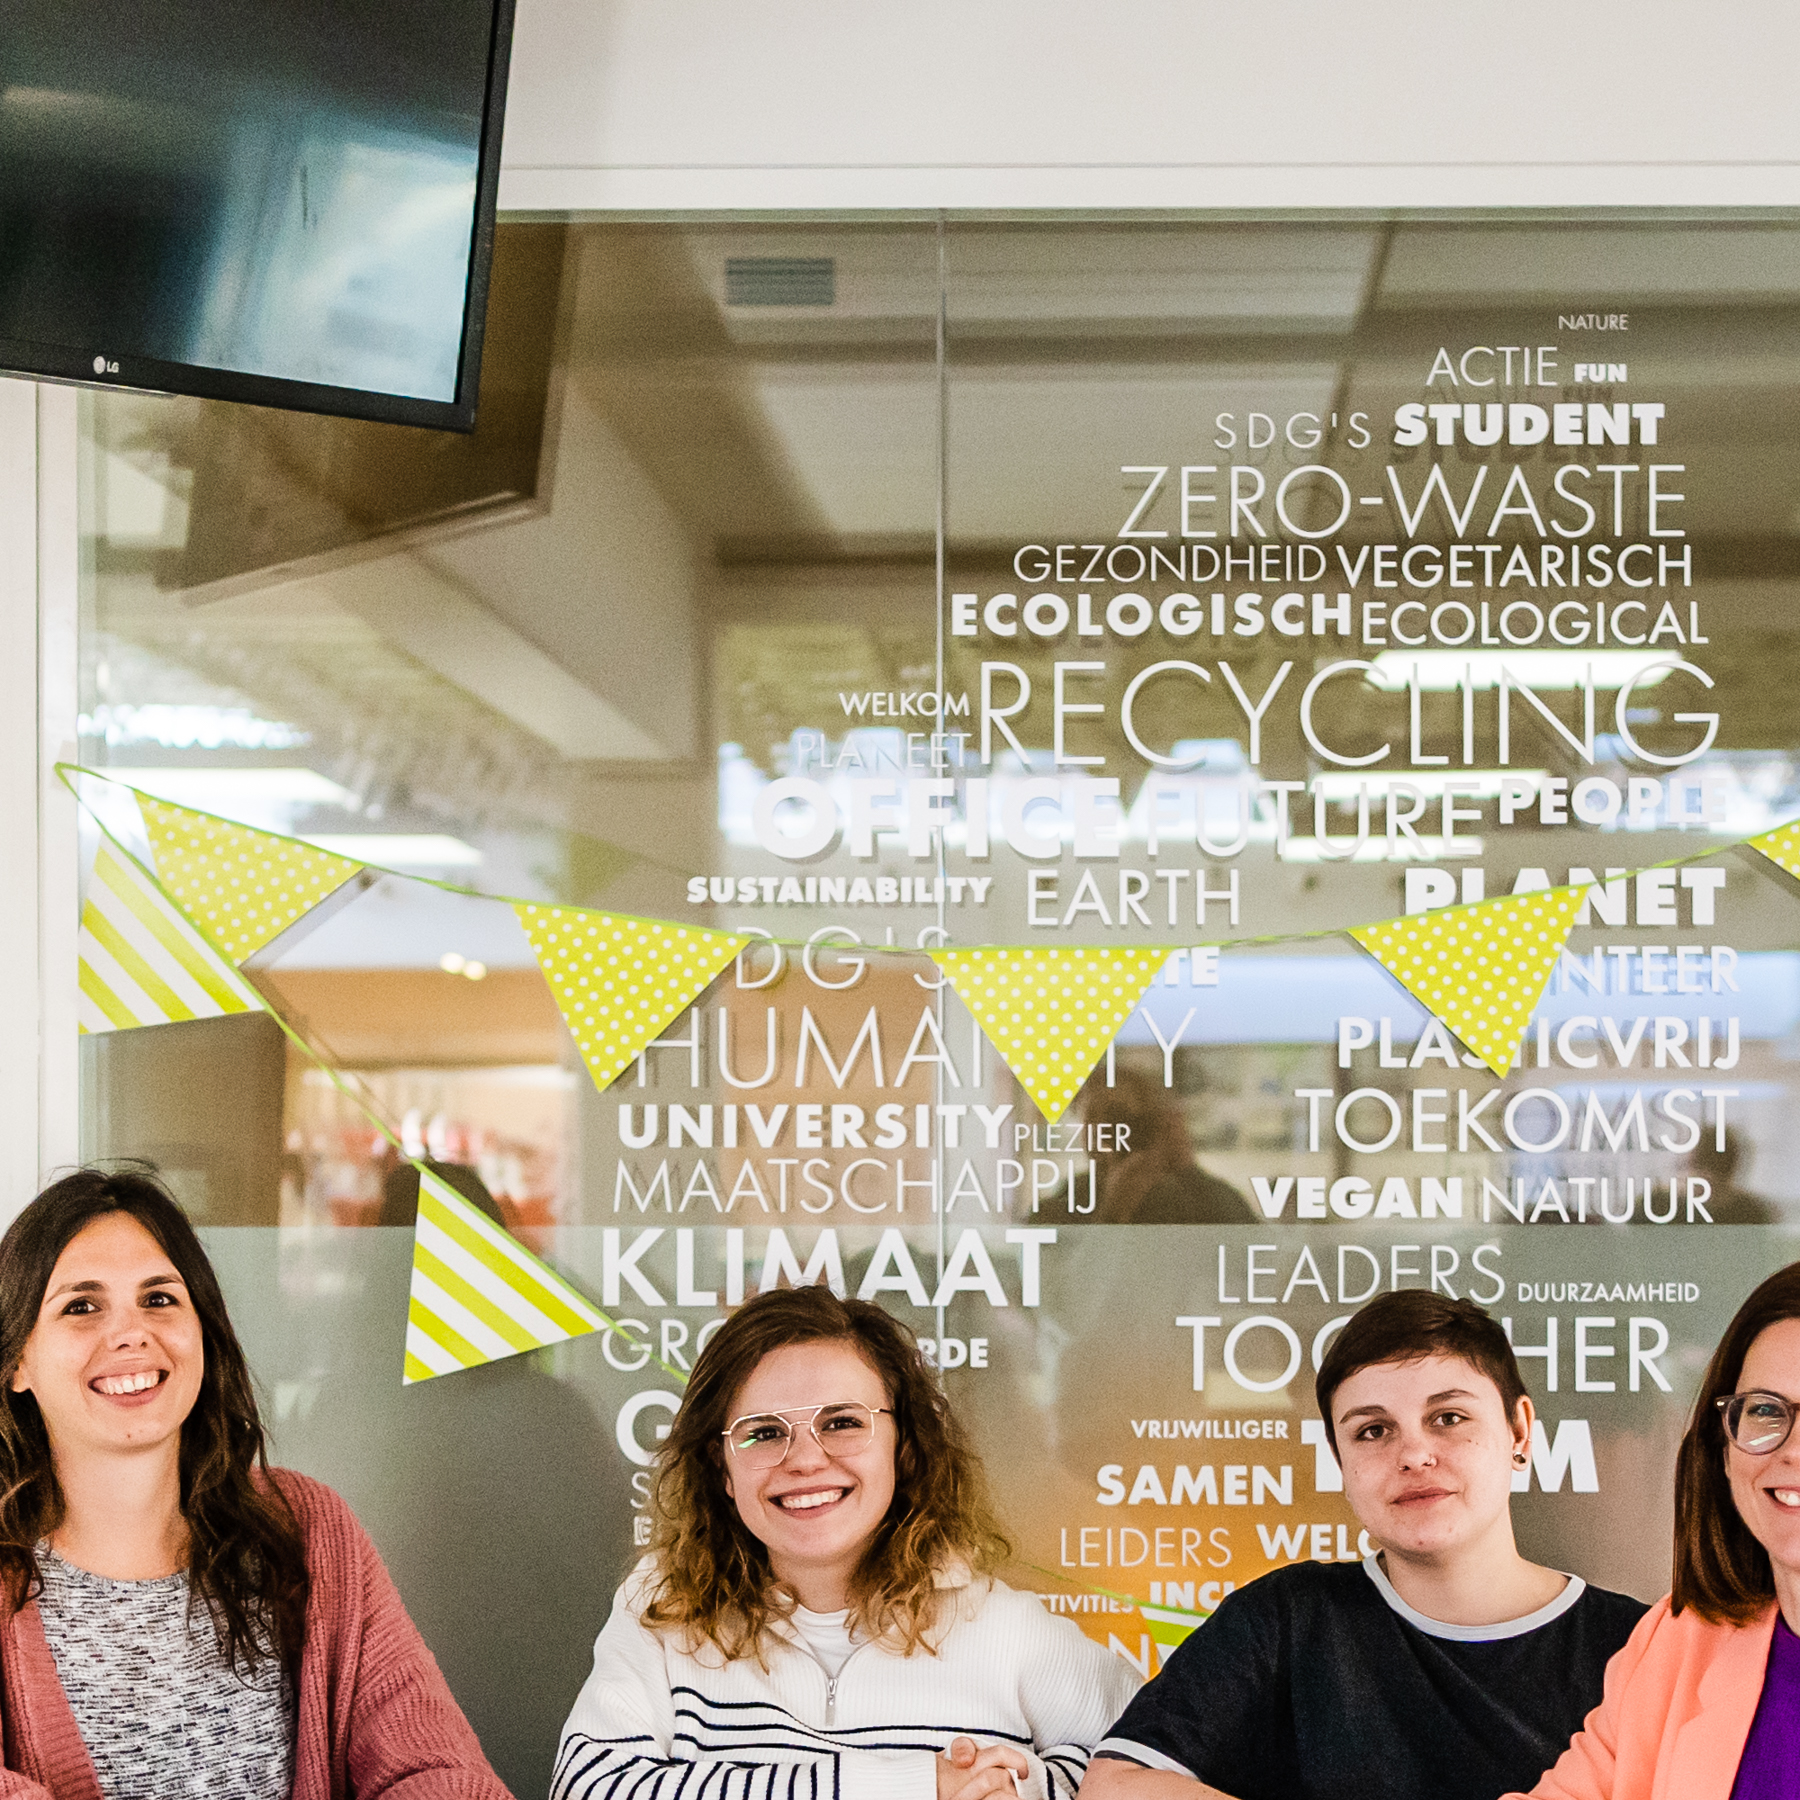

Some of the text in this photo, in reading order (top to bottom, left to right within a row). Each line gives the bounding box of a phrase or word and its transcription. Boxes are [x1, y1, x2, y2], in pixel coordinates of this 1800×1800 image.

[1558, 314, 1628, 330] NATURE
[1425, 346, 1627, 386] ACTIE FUN
[1213, 403, 1665, 450] SDG'S STUDENT
[1117, 464, 1686, 540] ZERO-WASTE
[1012, 543, 1692, 589] GEZONDHEID VEGETARISCH
[950, 593, 1709, 646] ECOLOGISCH ECOLOGICAL
[838, 660, 1720, 766] WELKOM RECYCLING
[798, 733, 973, 769] PLANEET
[752, 776, 1726, 858] OFFICE FUTURE PEOPLE
[686, 869, 1240, 926] SUSTAINABILITY EARTH
[618, 1104, 1131, 1152] UNIVERSITY PLEZIER
[1295, 1087, 1740, 1154] TOEKOMST
[613, 1158, 1098, 1214] MAATSCHAPPIJ
[1251, 1176, 1713, 1224] VEGAN NATUUR
[602, 1228, 1057, 1307] KLIMAAT
[1217, 1245, 1699, 1304] LEADERS DUURZAAMHEID
[1131, 1418, 1288, 1440] VRIJWILLIGER
[1095, 1463, 1292, 1506] SAMEN
[1060, 1527, 1232, 1568] LEIDERS
